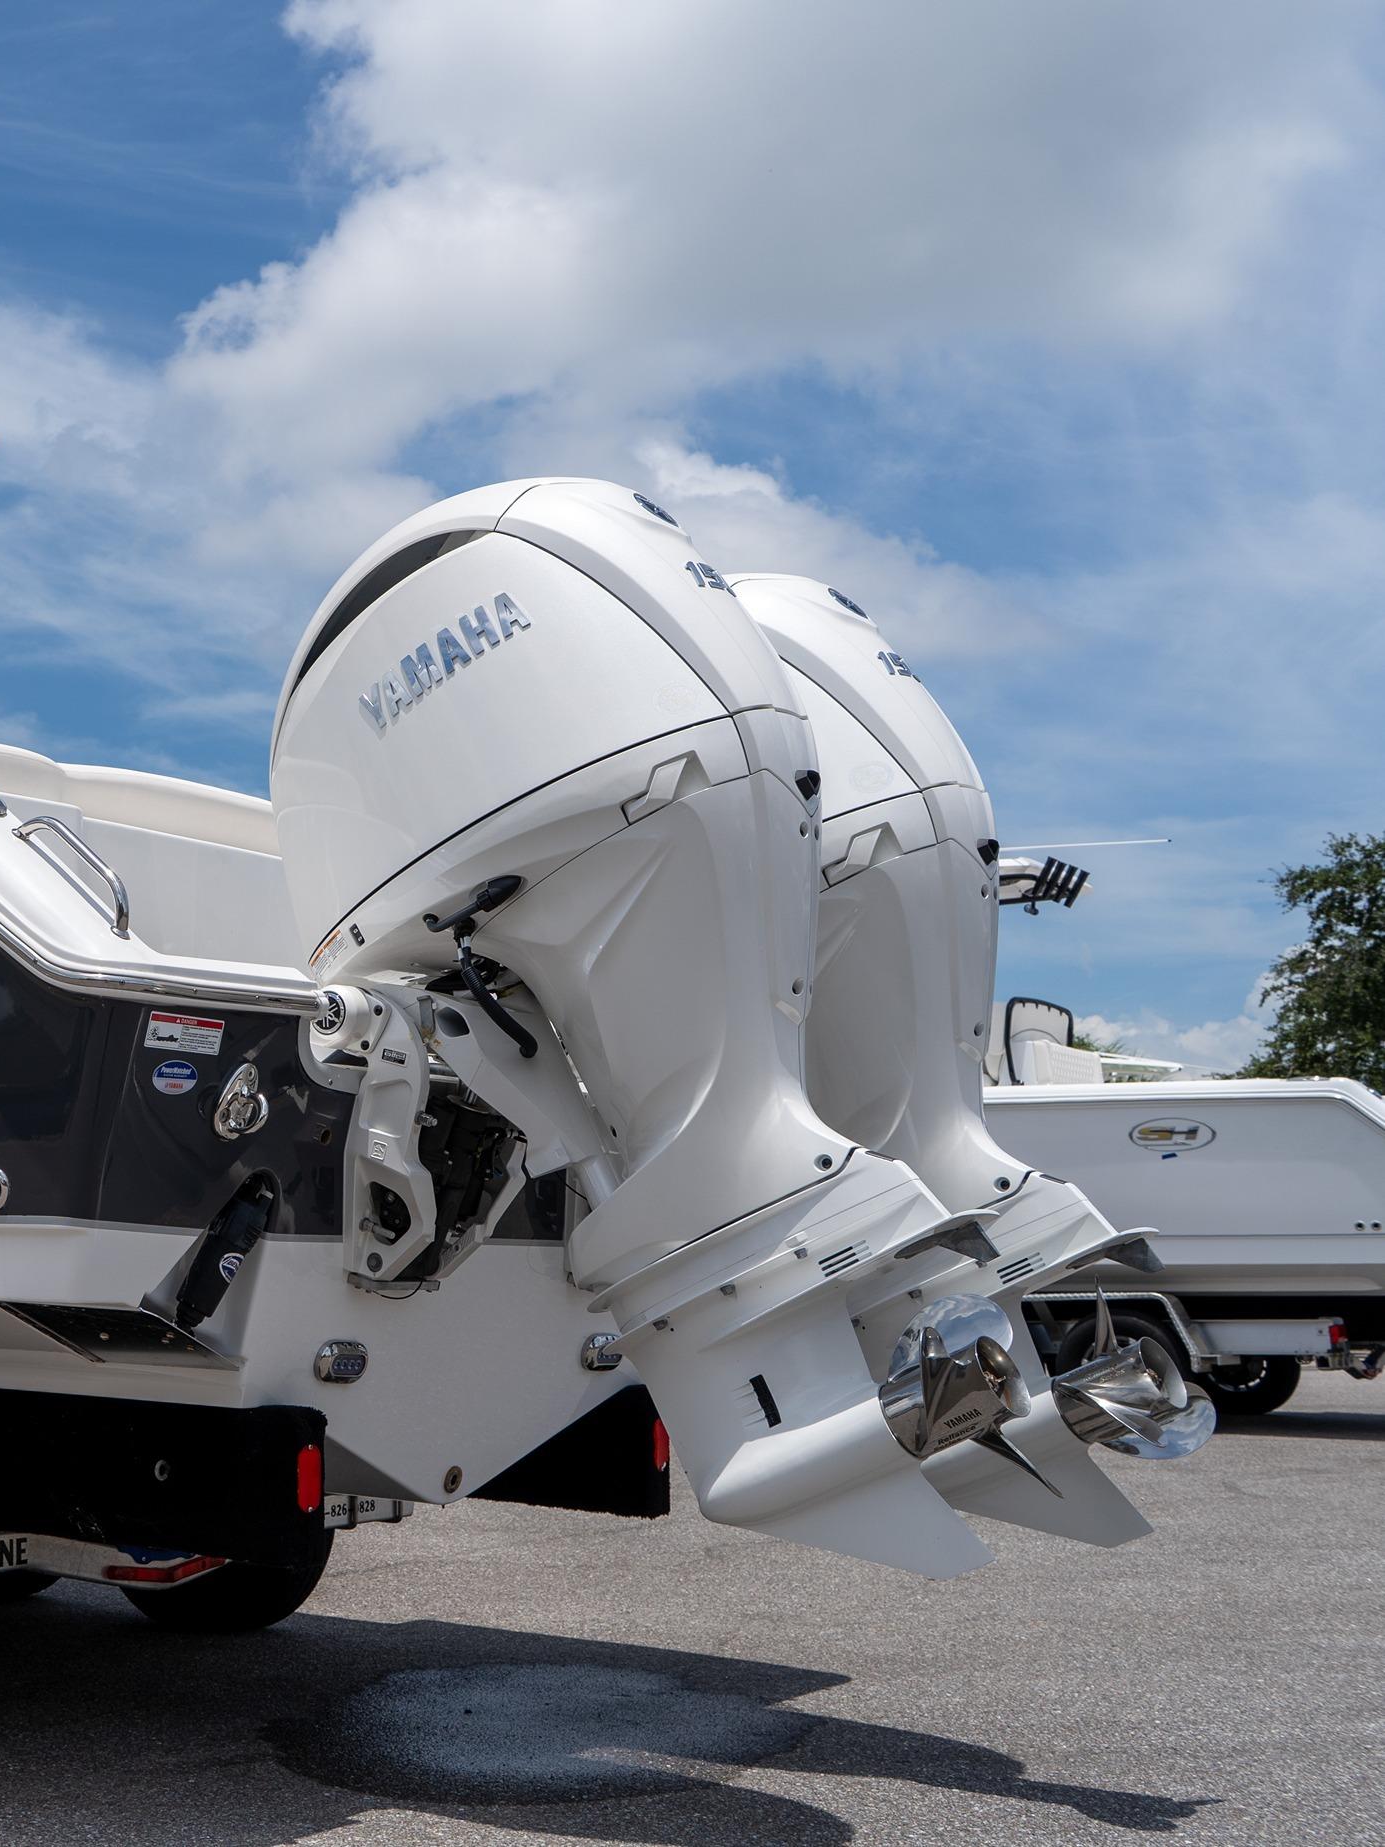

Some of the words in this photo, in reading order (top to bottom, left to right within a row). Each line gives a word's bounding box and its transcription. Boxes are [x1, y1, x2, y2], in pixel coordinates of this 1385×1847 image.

[685, 561, 736, 597] 15
[359, 592, 532, 731] YAMAHA
[877, 651, 921, 683] 15
[943, 1408, 982, 1429] YAMAHA
